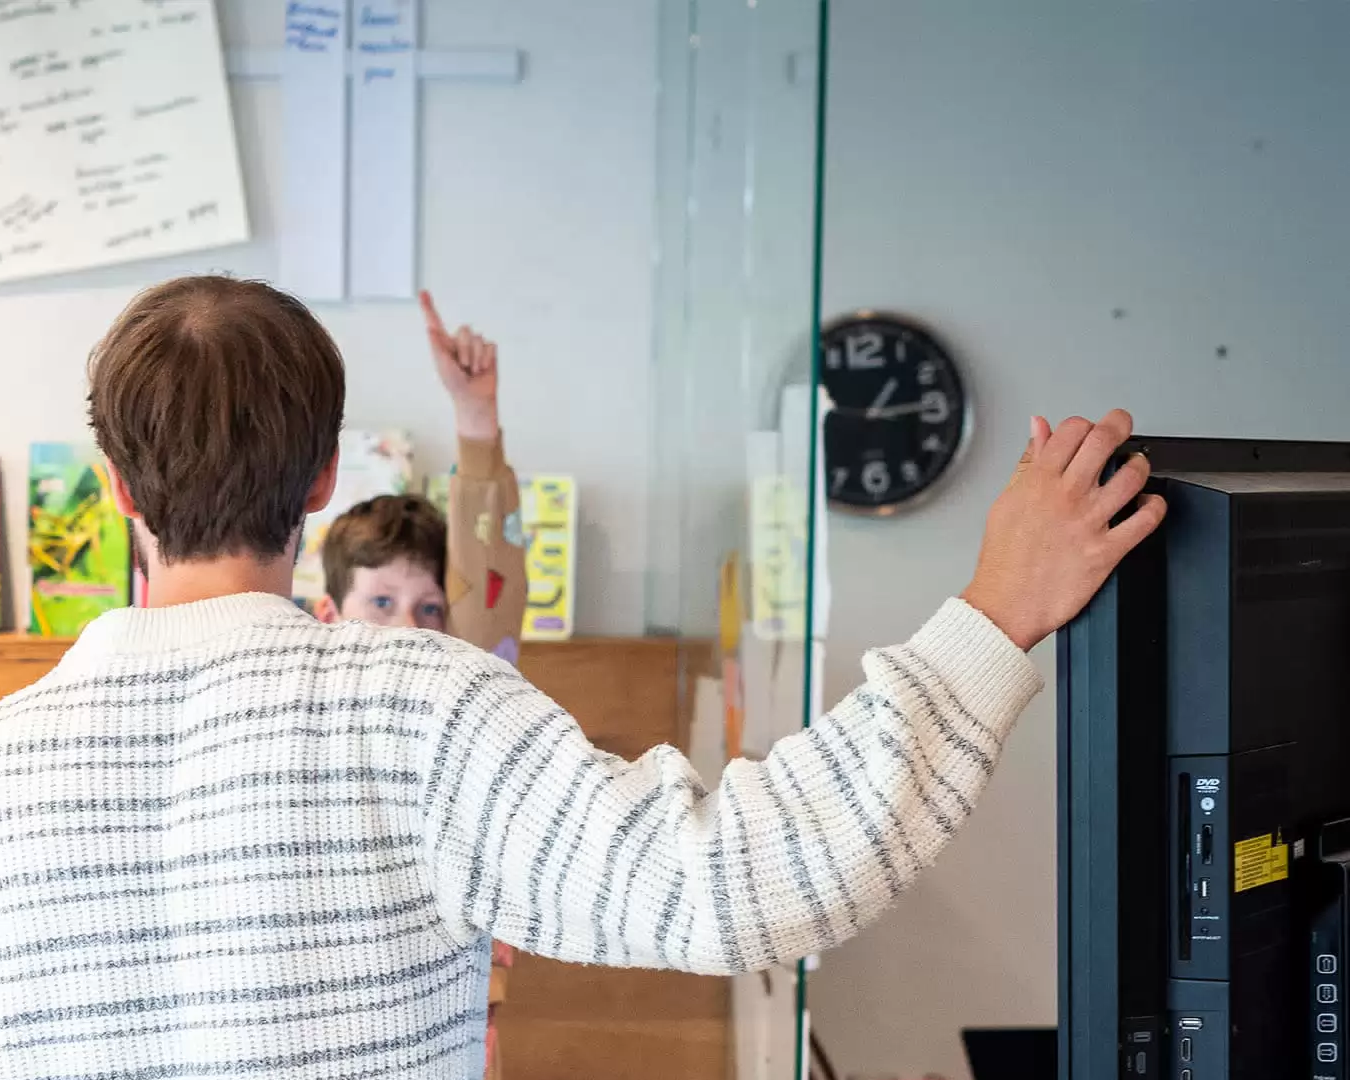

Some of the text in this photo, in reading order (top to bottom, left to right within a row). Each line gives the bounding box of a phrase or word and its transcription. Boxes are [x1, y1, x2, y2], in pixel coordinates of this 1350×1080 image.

[845, 333, 887, 369] 12
[920, 391, 949, 424] 3
[861, 460, 891, 494] 6
[1196, 778, 1220, 786] DVD
